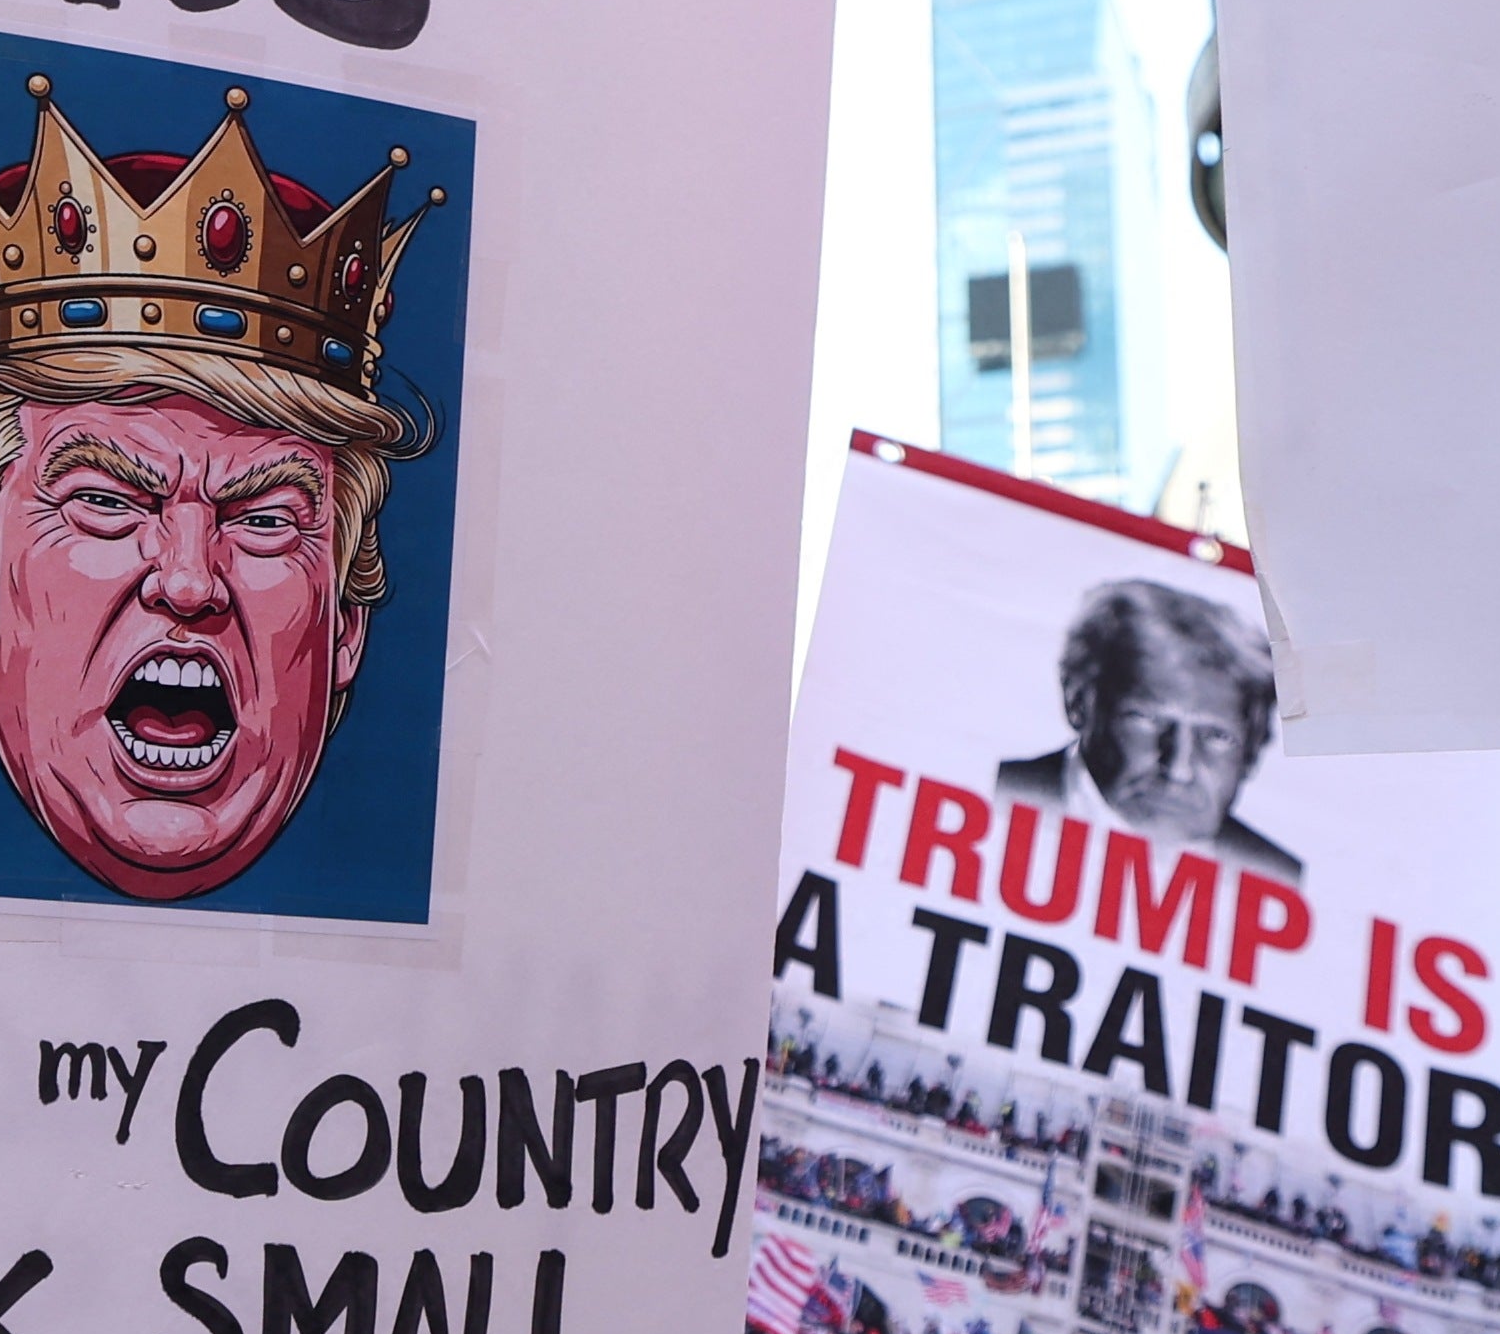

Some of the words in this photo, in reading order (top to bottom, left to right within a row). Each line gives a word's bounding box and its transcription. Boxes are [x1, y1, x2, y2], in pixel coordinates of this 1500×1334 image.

[773, 870, 842, 1001] A
[832, 745, 1313, 988] TRUMP
[1364, 917, 1491, 1058] IS
[38, 1038, 169, 1145] my
[175, 997, 761, 1258] COUNTRY
